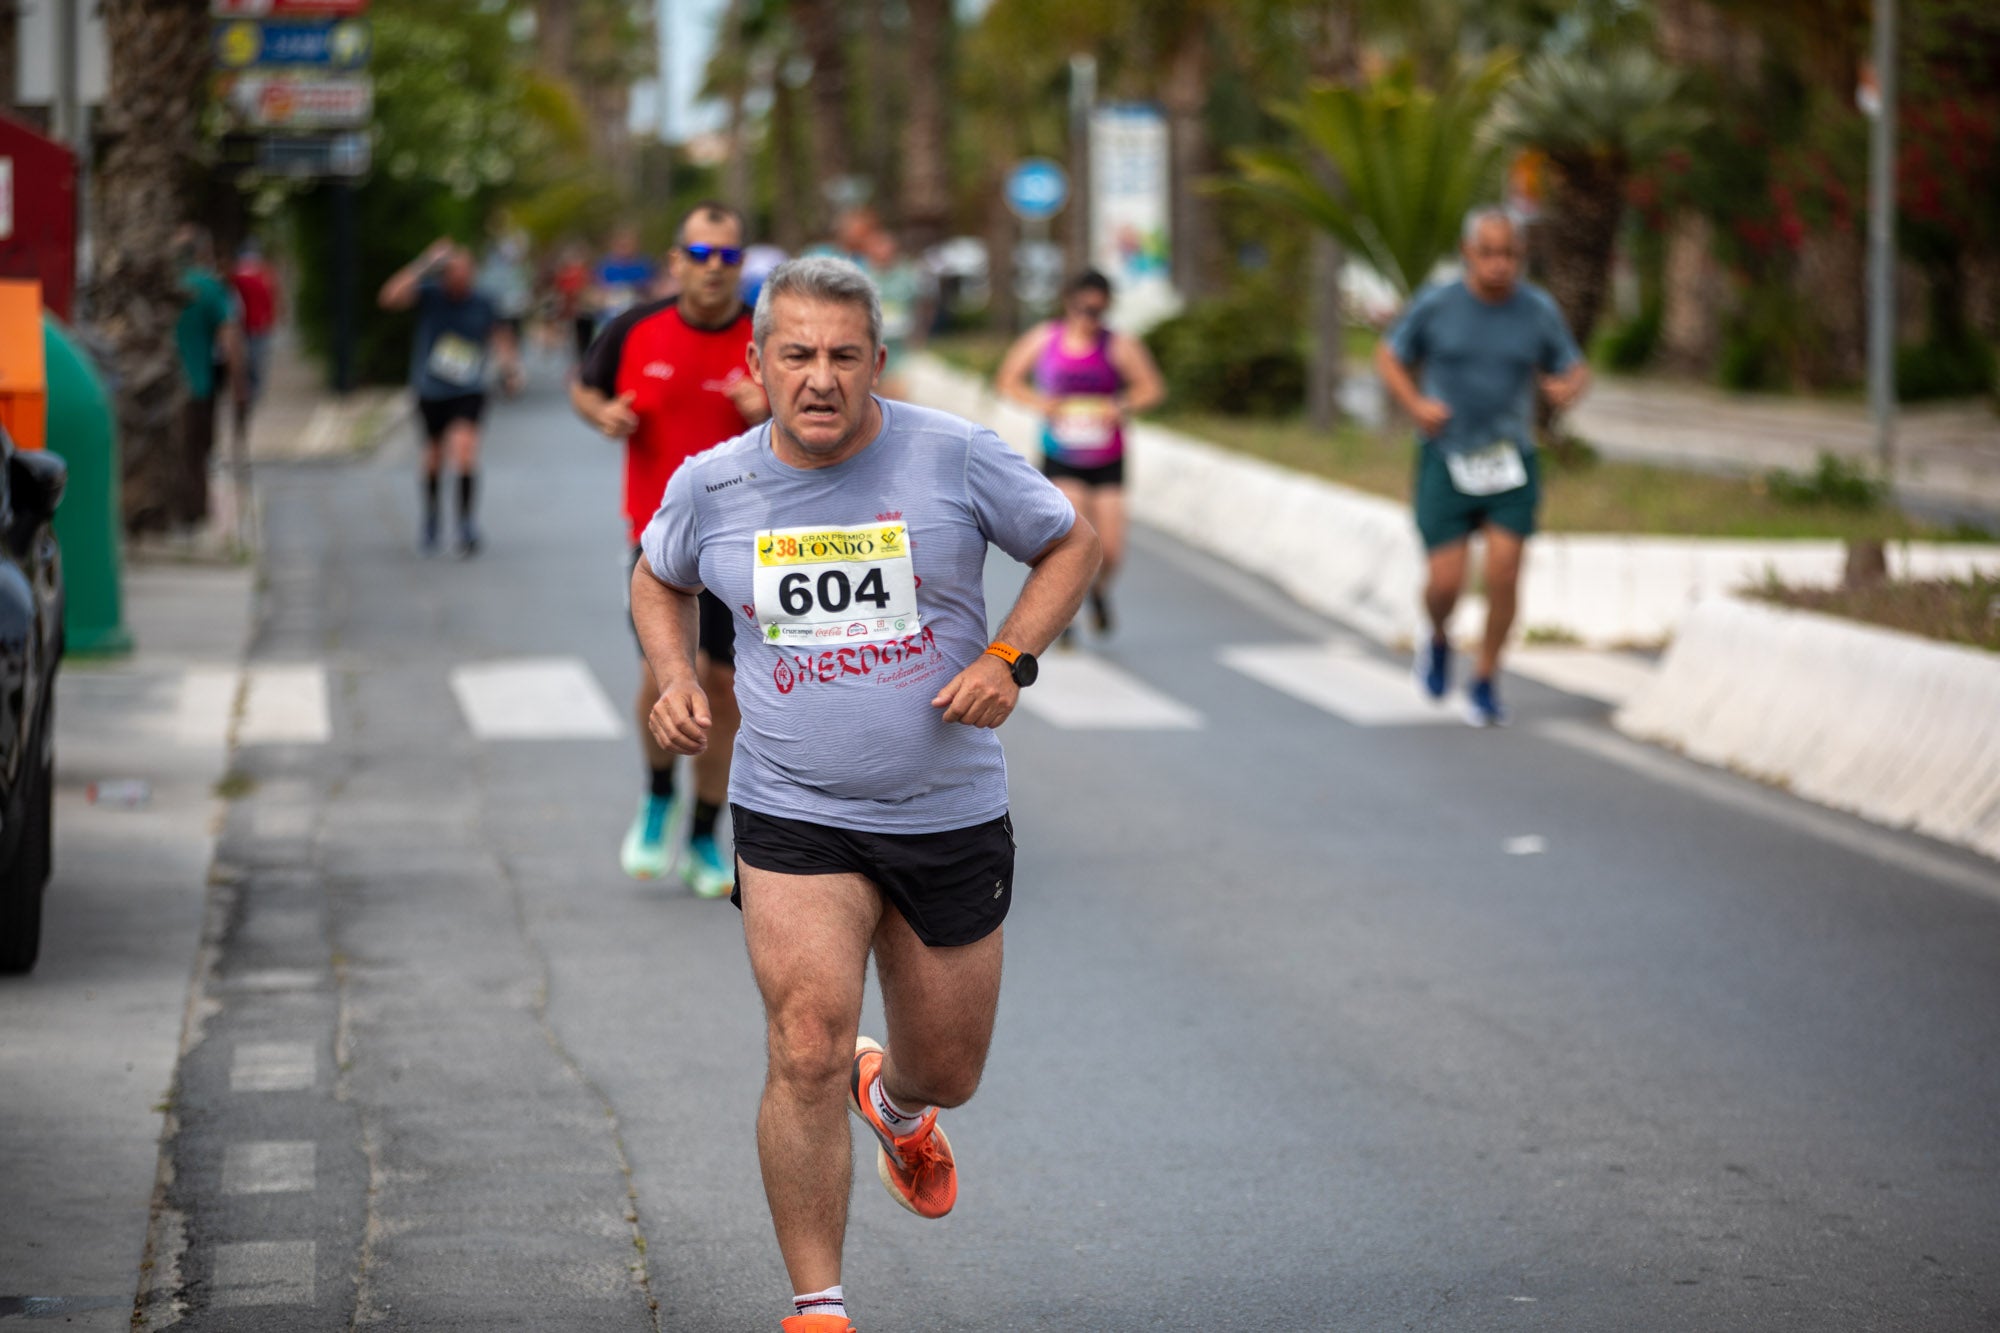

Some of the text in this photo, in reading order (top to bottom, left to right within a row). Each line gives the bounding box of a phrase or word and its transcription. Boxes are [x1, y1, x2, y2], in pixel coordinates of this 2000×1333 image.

[705, 474, 743, 493] luanvi
[777, 538, 875, 557] 38 FONDO
[802, 535, 829, 543] GRAN
[832, 533, 866, 542] PREMIO
[779, 568, 891, 617] 604
[782, 627, 813, 635] Cruzcampo
[794, 625, 937, 684] HEROGRA
